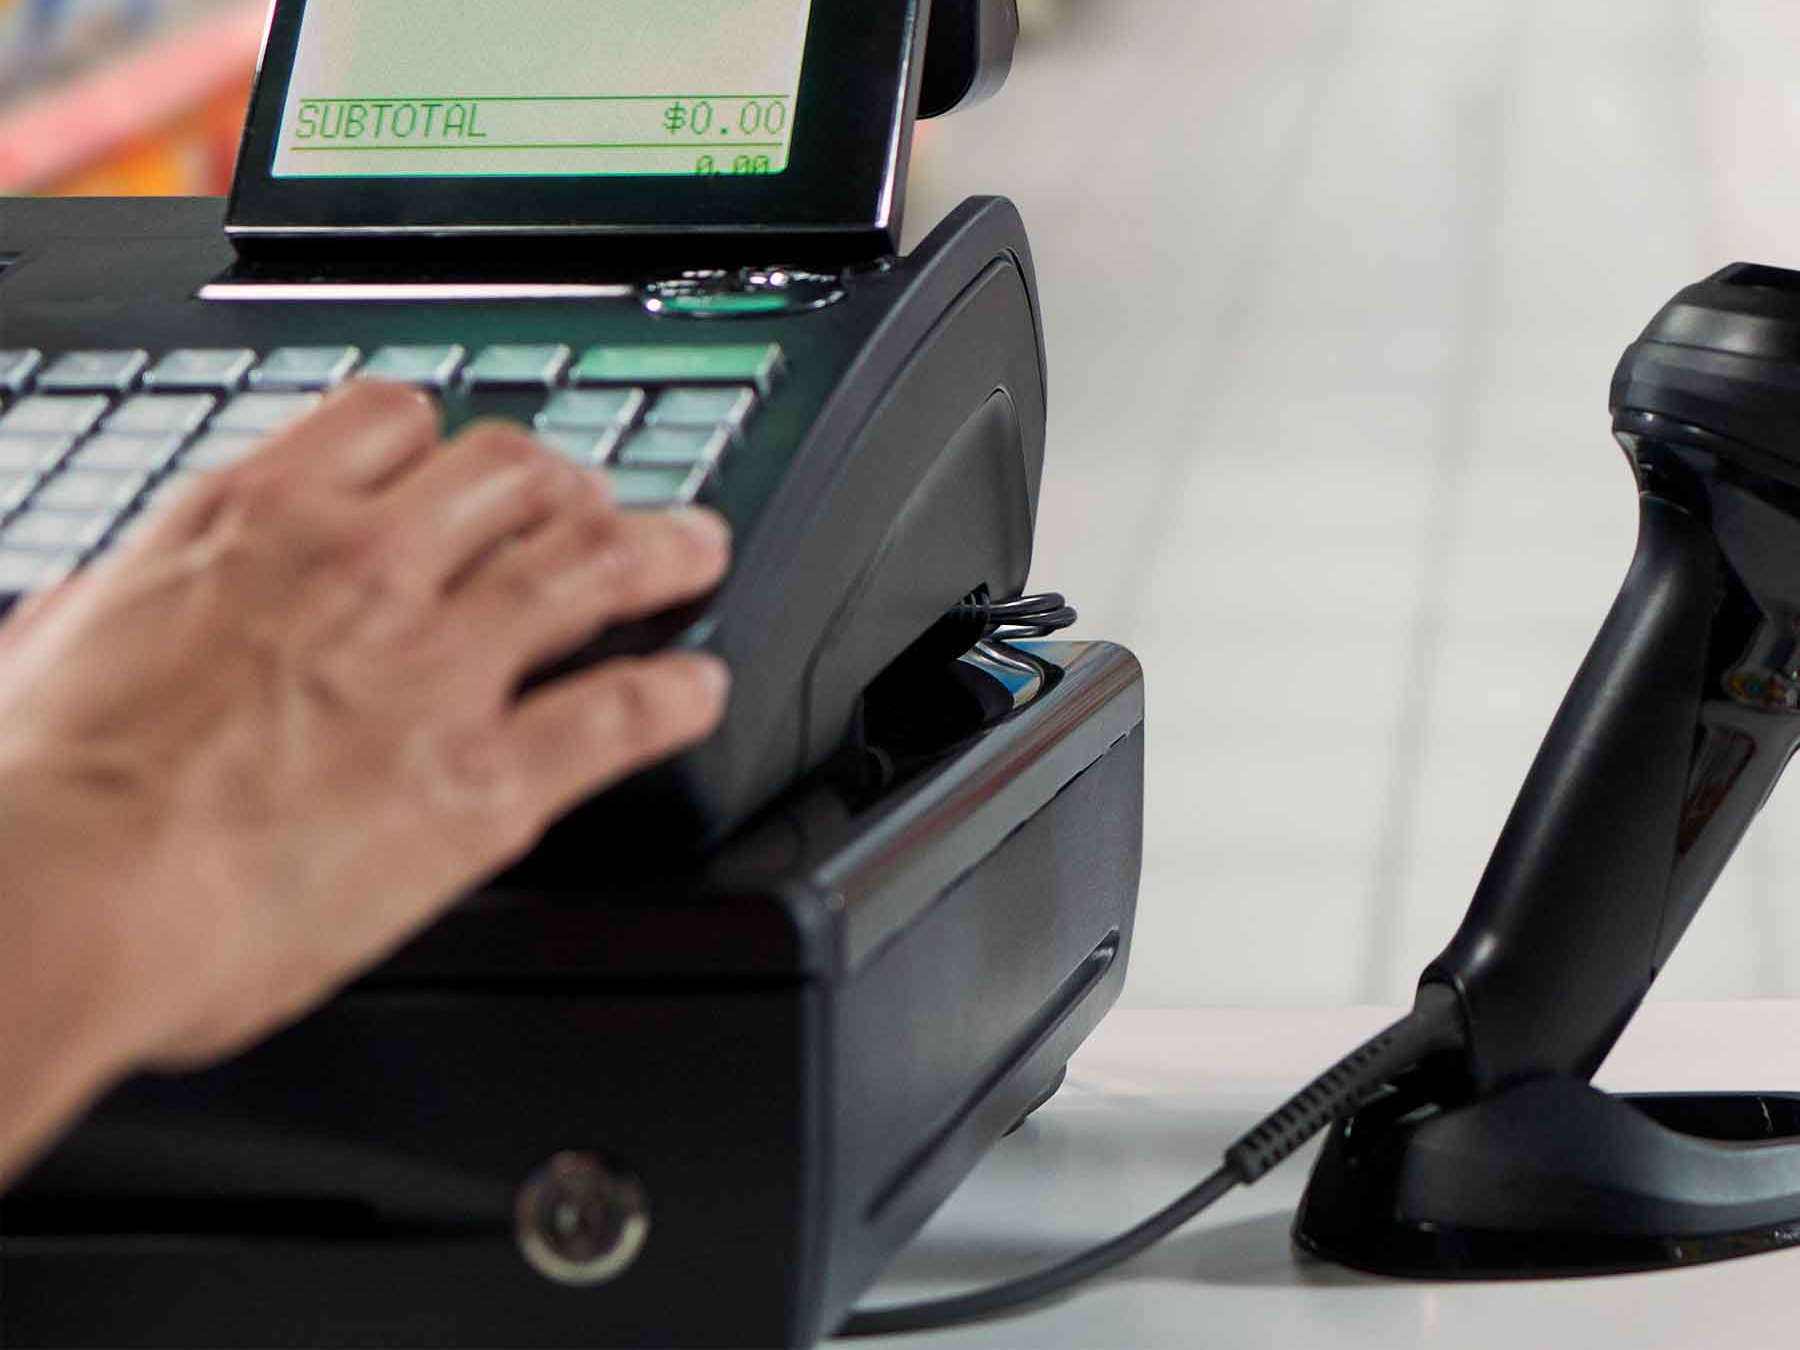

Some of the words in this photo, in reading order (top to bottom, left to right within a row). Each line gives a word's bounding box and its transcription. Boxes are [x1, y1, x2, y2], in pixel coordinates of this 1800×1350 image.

[294, 100, 488, 140] SUBTOTAL
[662, 98, 786, 137] $0.00
[694, 154, 771, 176] 0.00
